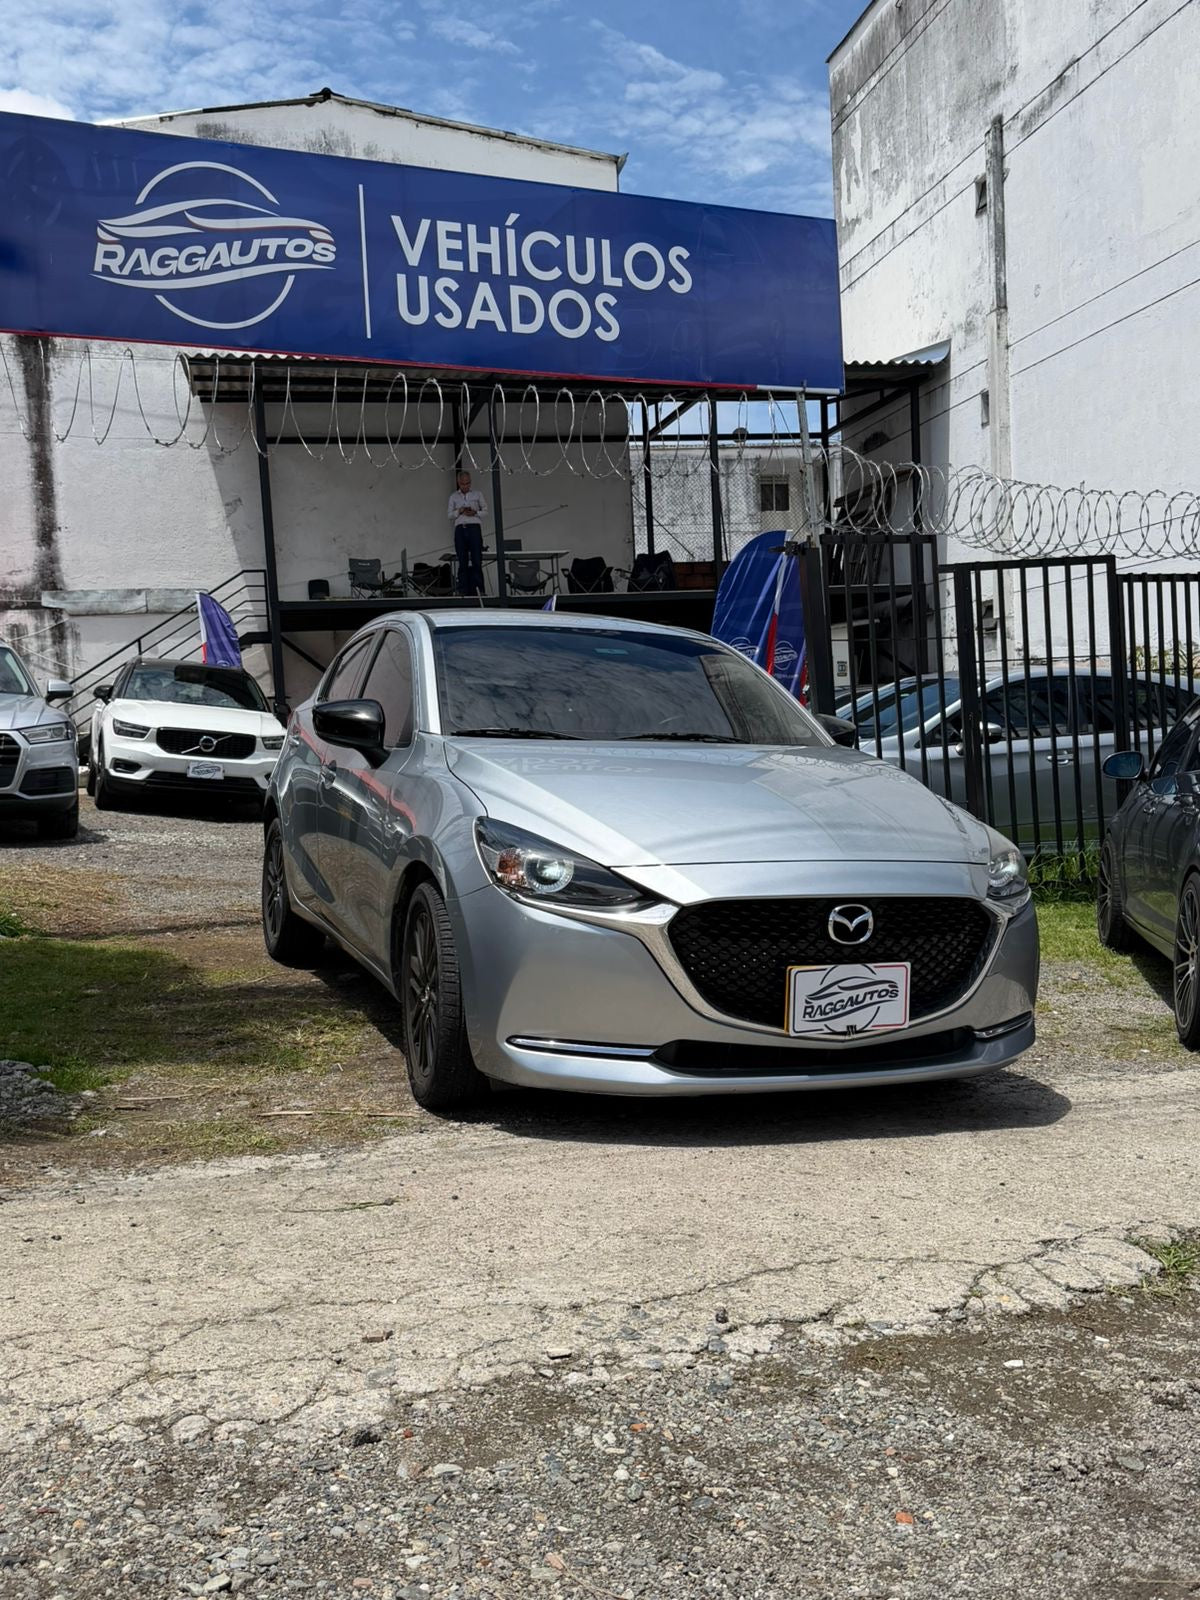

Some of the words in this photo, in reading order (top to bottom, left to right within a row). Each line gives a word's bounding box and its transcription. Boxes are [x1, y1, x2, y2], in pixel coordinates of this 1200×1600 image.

[93, 237, 337, 276] RAGGAUTOS
[391, 213, 693, 294] VEHÍCULOS
[396, 273, 621, 342] USADOS
[802, 988, 899, 1019] RAGGAUTOS
